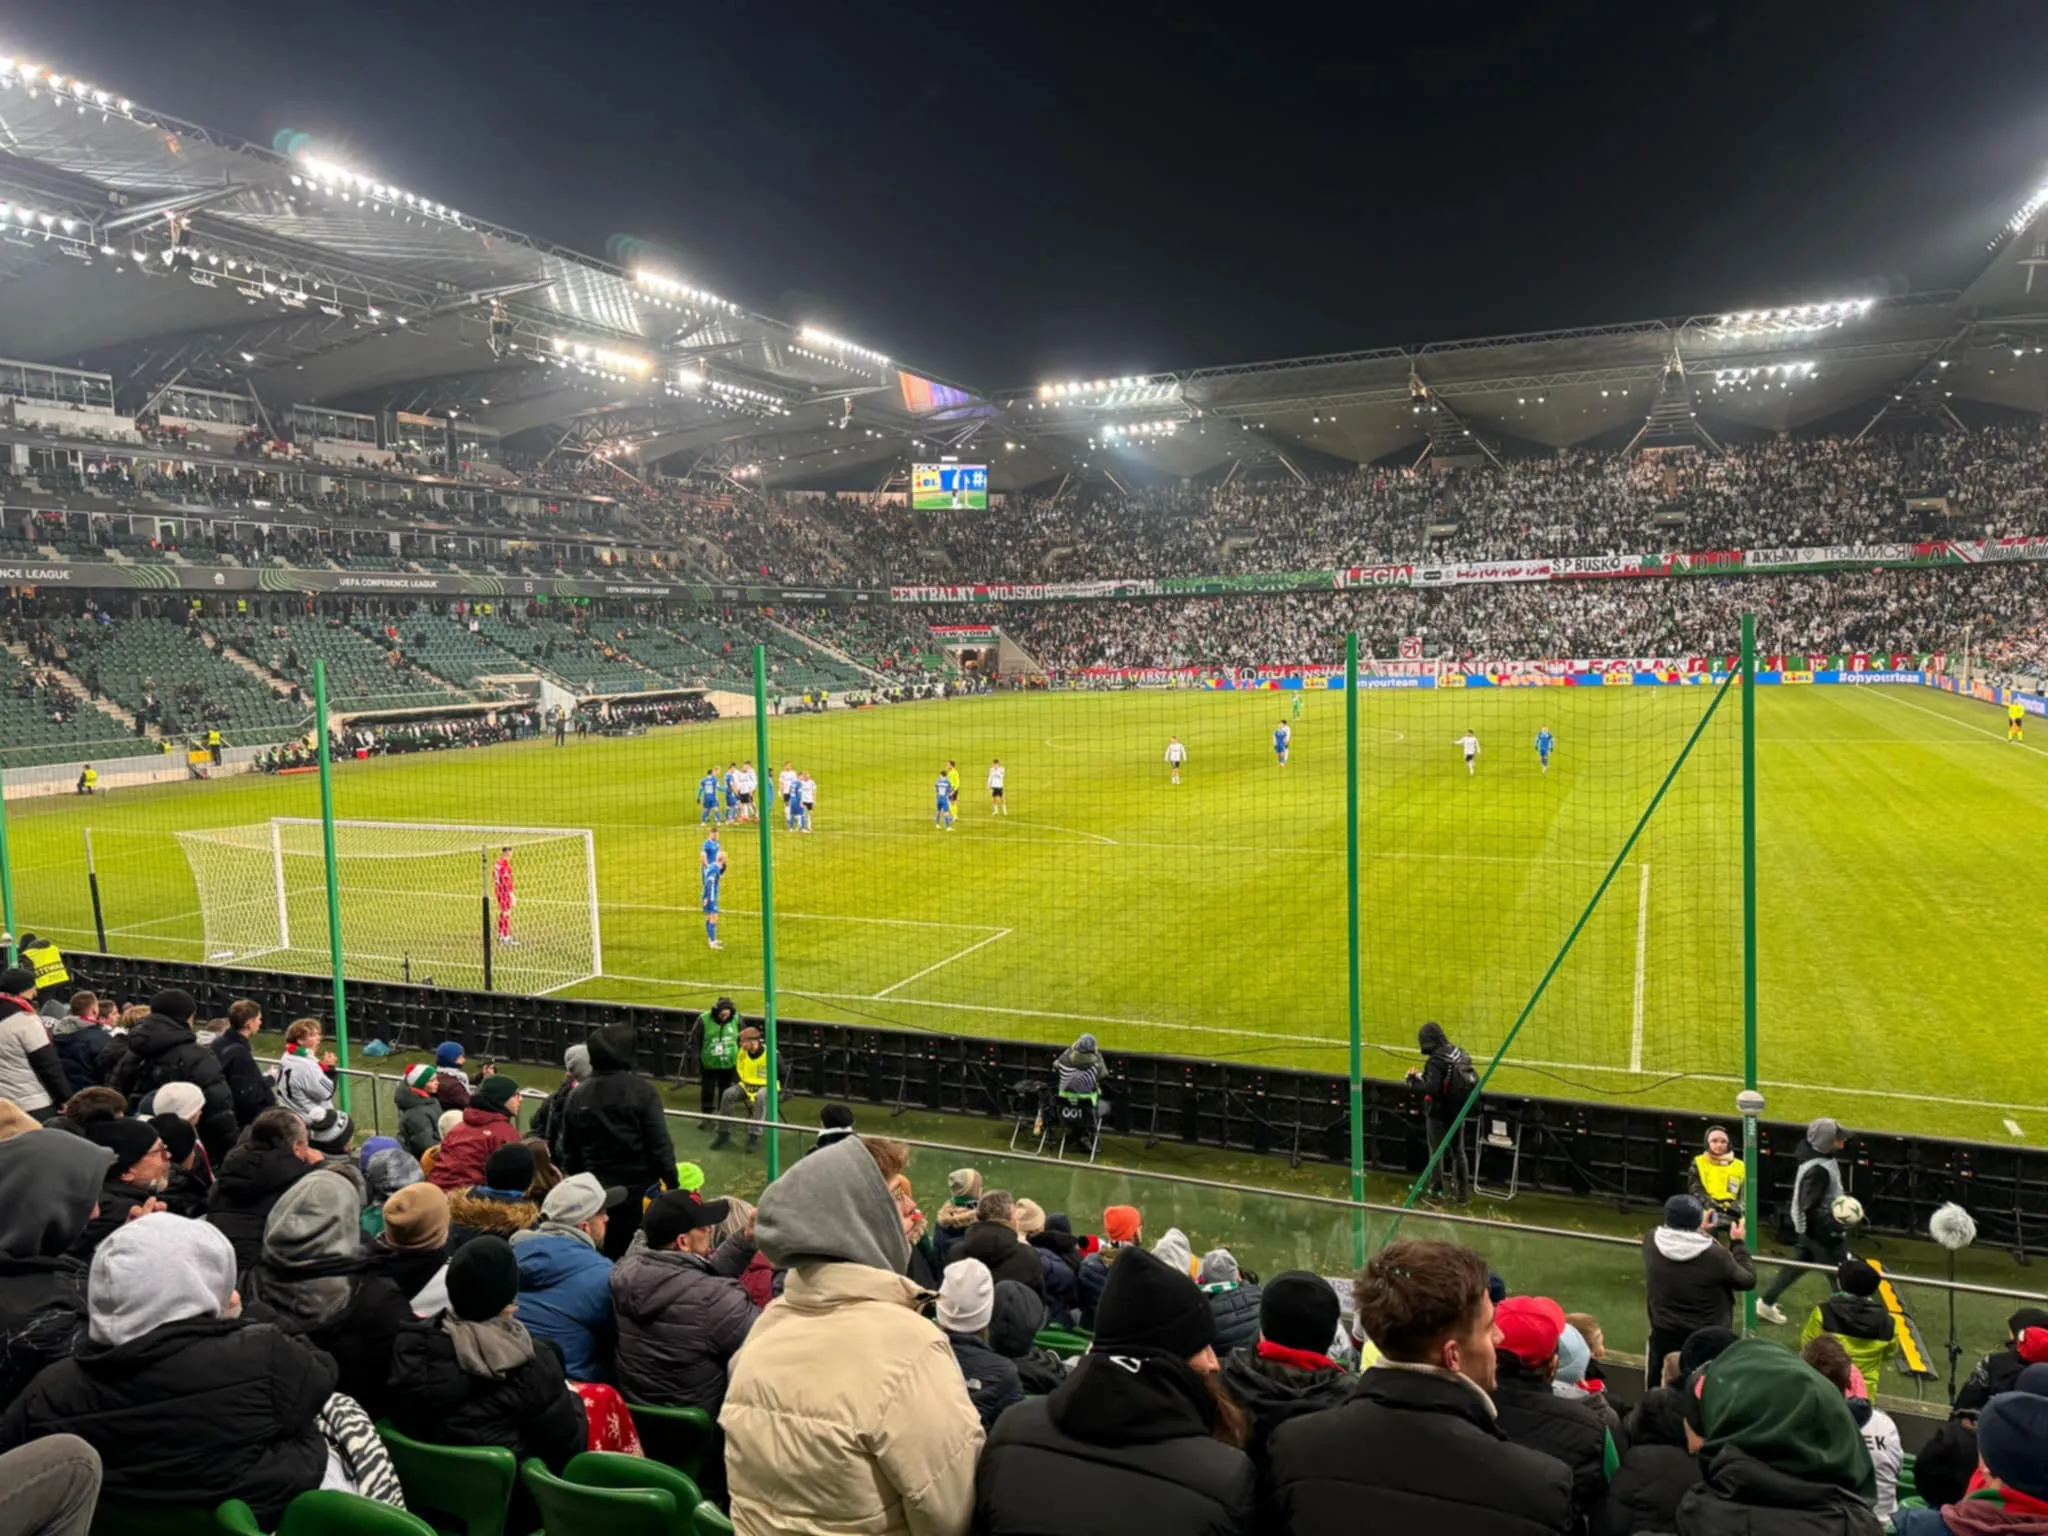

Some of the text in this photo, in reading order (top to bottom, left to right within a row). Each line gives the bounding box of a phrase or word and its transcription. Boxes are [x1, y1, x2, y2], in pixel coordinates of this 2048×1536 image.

[1574, 557, 1621, 571] BUSKO
[25, 569, 72, 580] LEAGUE
[1346, 566, 1410, 586] LEGIA
[890, 585, 975, 602] CENTRALNY
[1357, 679, 1418, 689] nyourteam
[1062, 1107, 1082, 1118] 001
